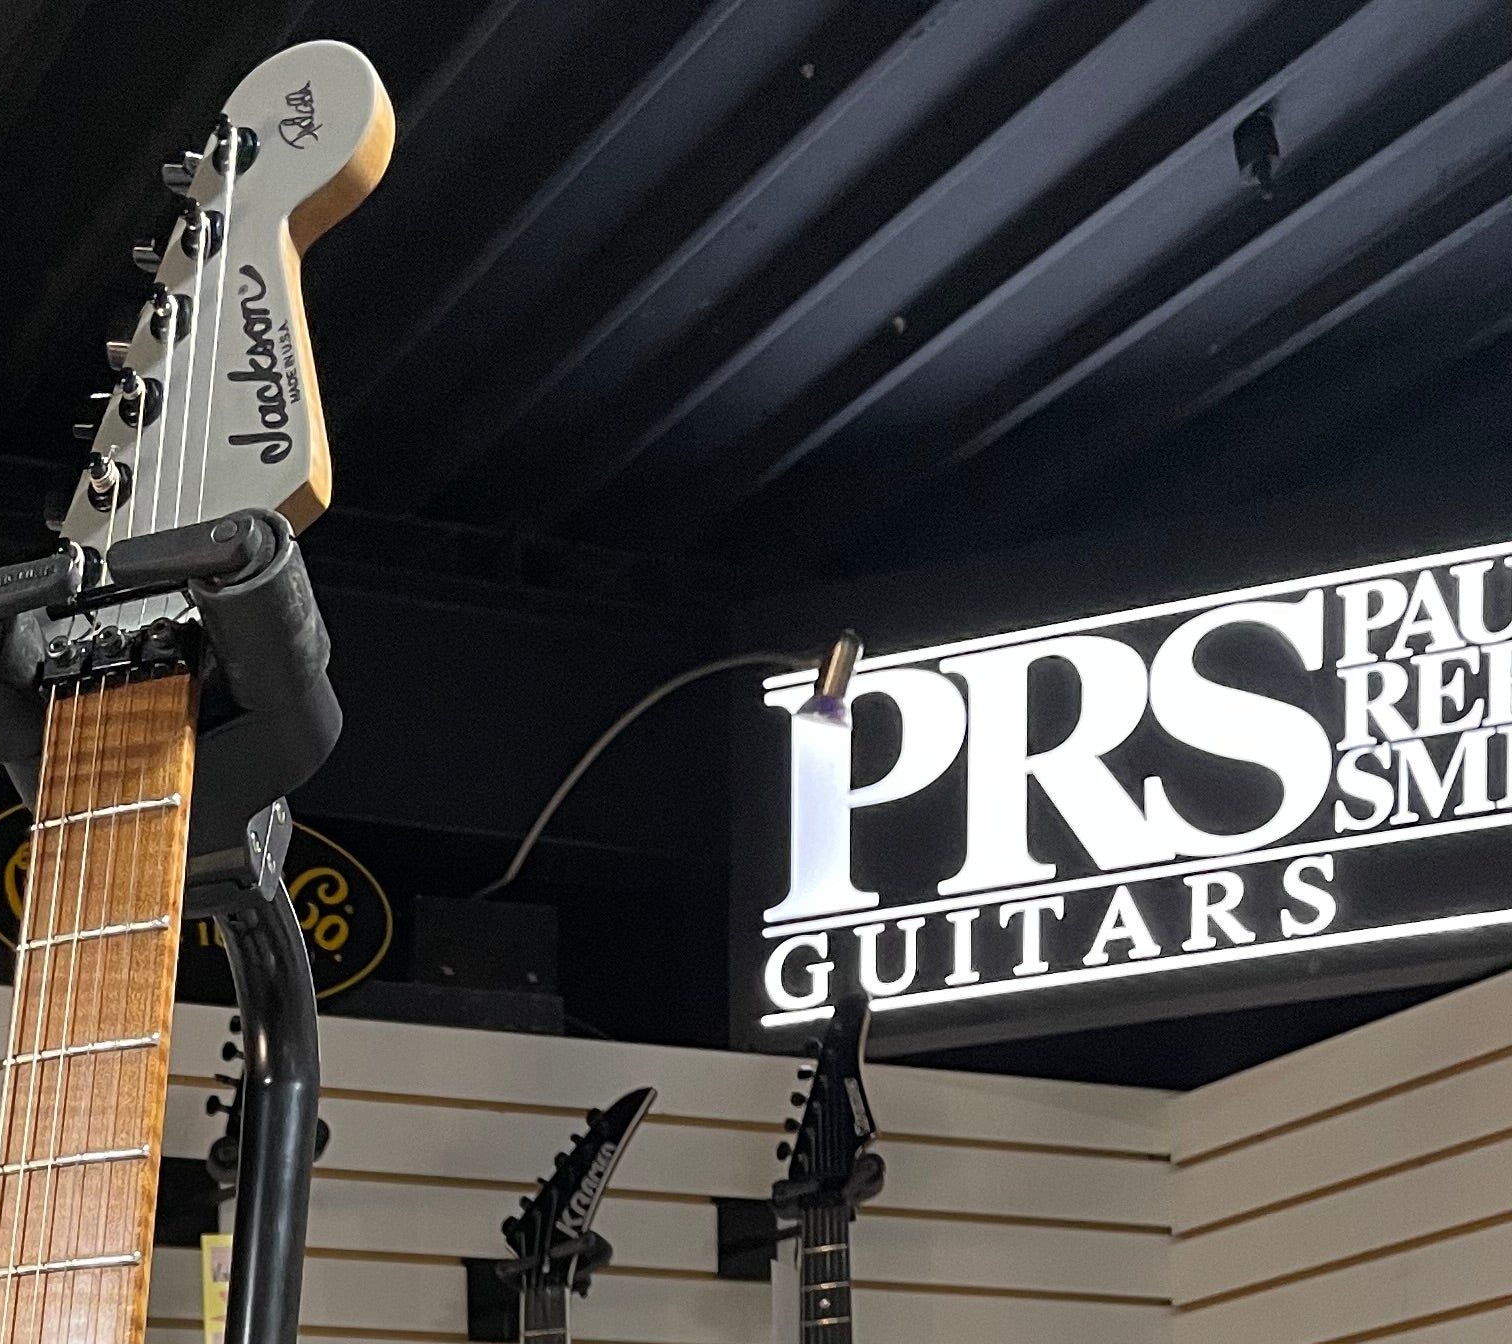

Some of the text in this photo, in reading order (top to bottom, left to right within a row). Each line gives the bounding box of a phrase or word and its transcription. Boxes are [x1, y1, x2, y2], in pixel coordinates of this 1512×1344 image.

[227, 264, 293, 465] Jackson
[763, 589, 1333, 923] PRS
[763, 854, 1338, 1011] GUITARS
